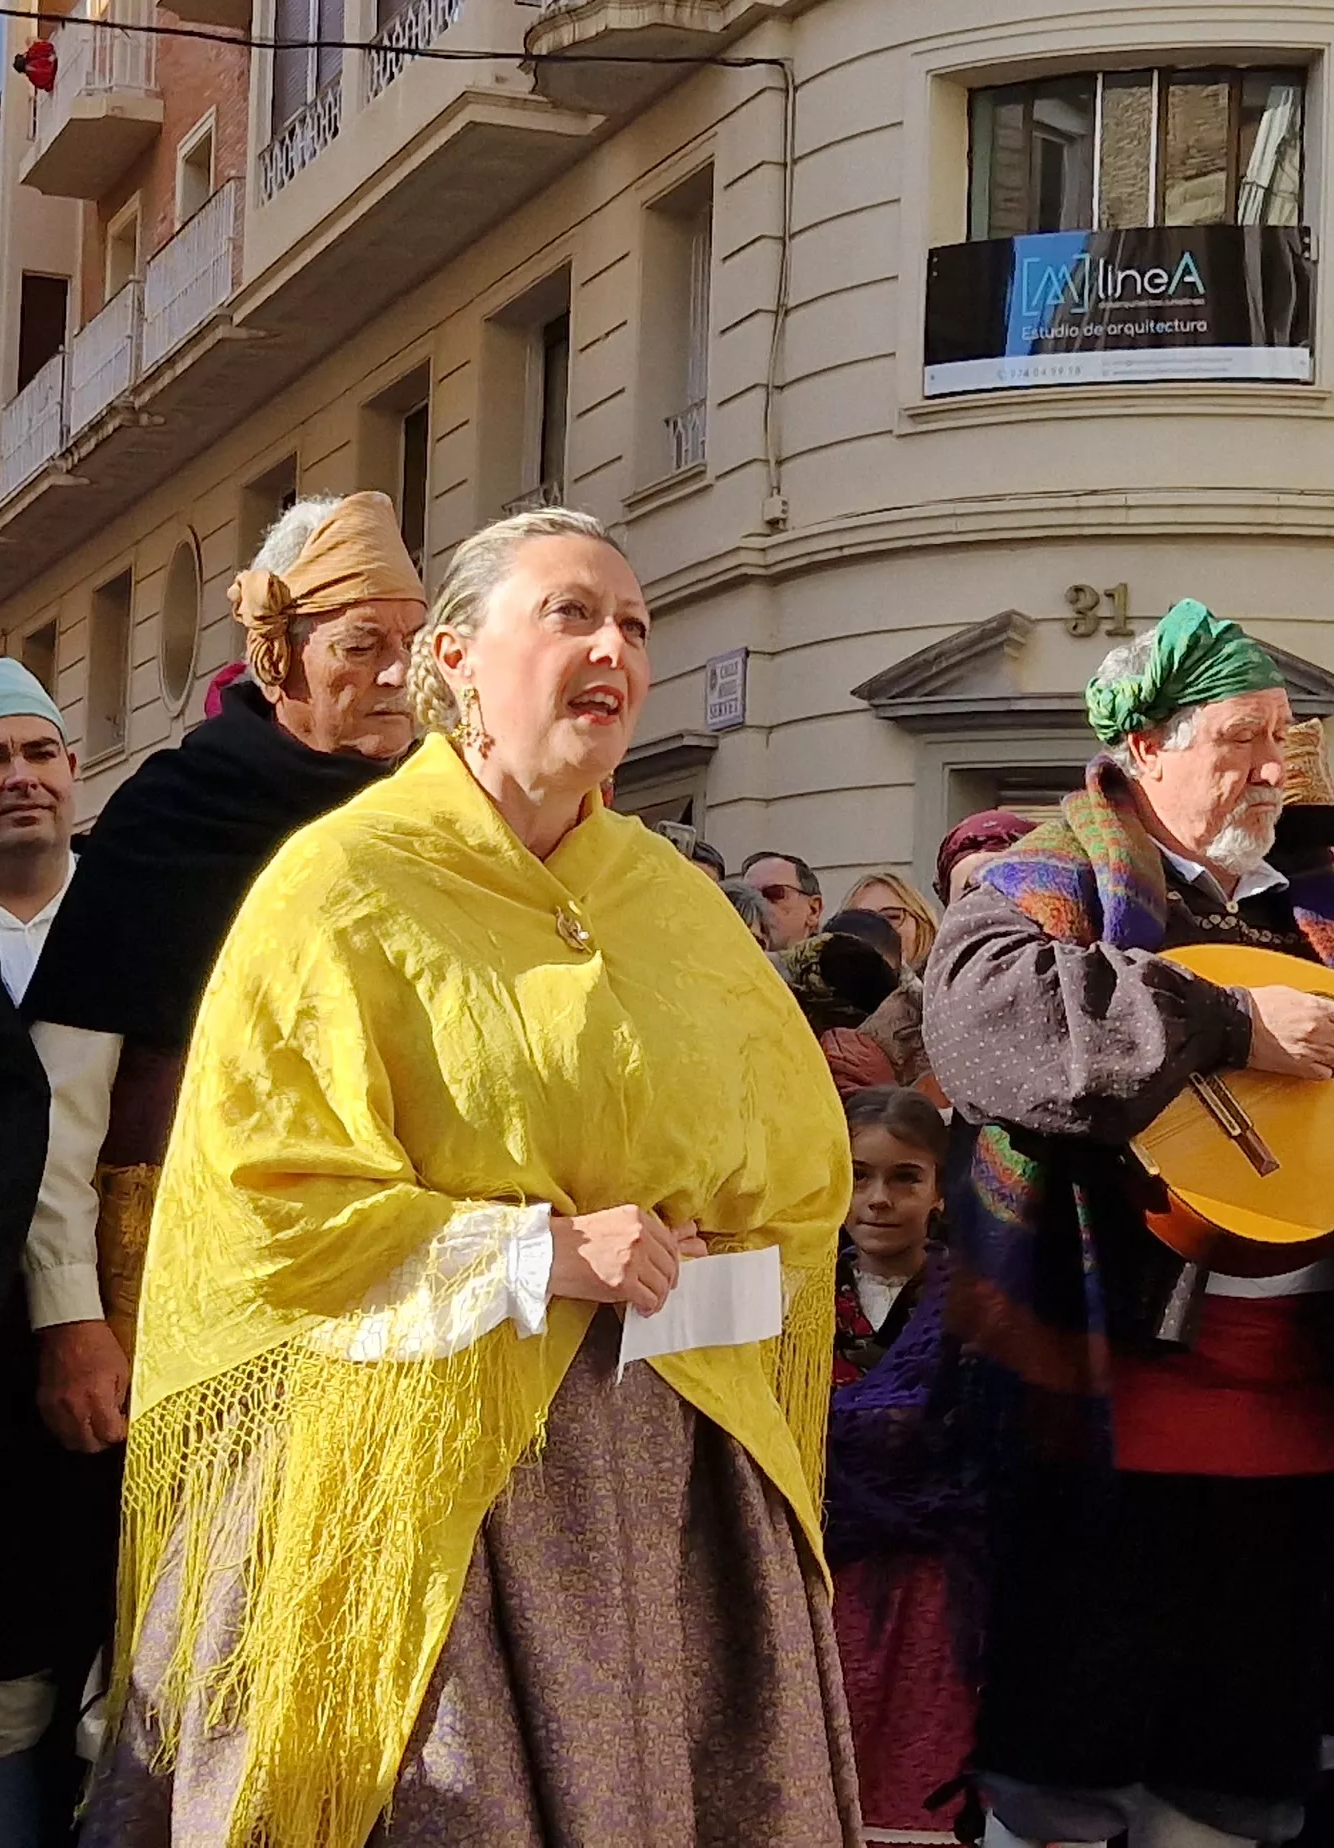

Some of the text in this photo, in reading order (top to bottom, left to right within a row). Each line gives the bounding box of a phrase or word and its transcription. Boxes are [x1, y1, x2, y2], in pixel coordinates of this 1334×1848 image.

[1021, 318, 1208, 341] Estudio de arquitectura
[1065, 583, 1135, 638] 31
